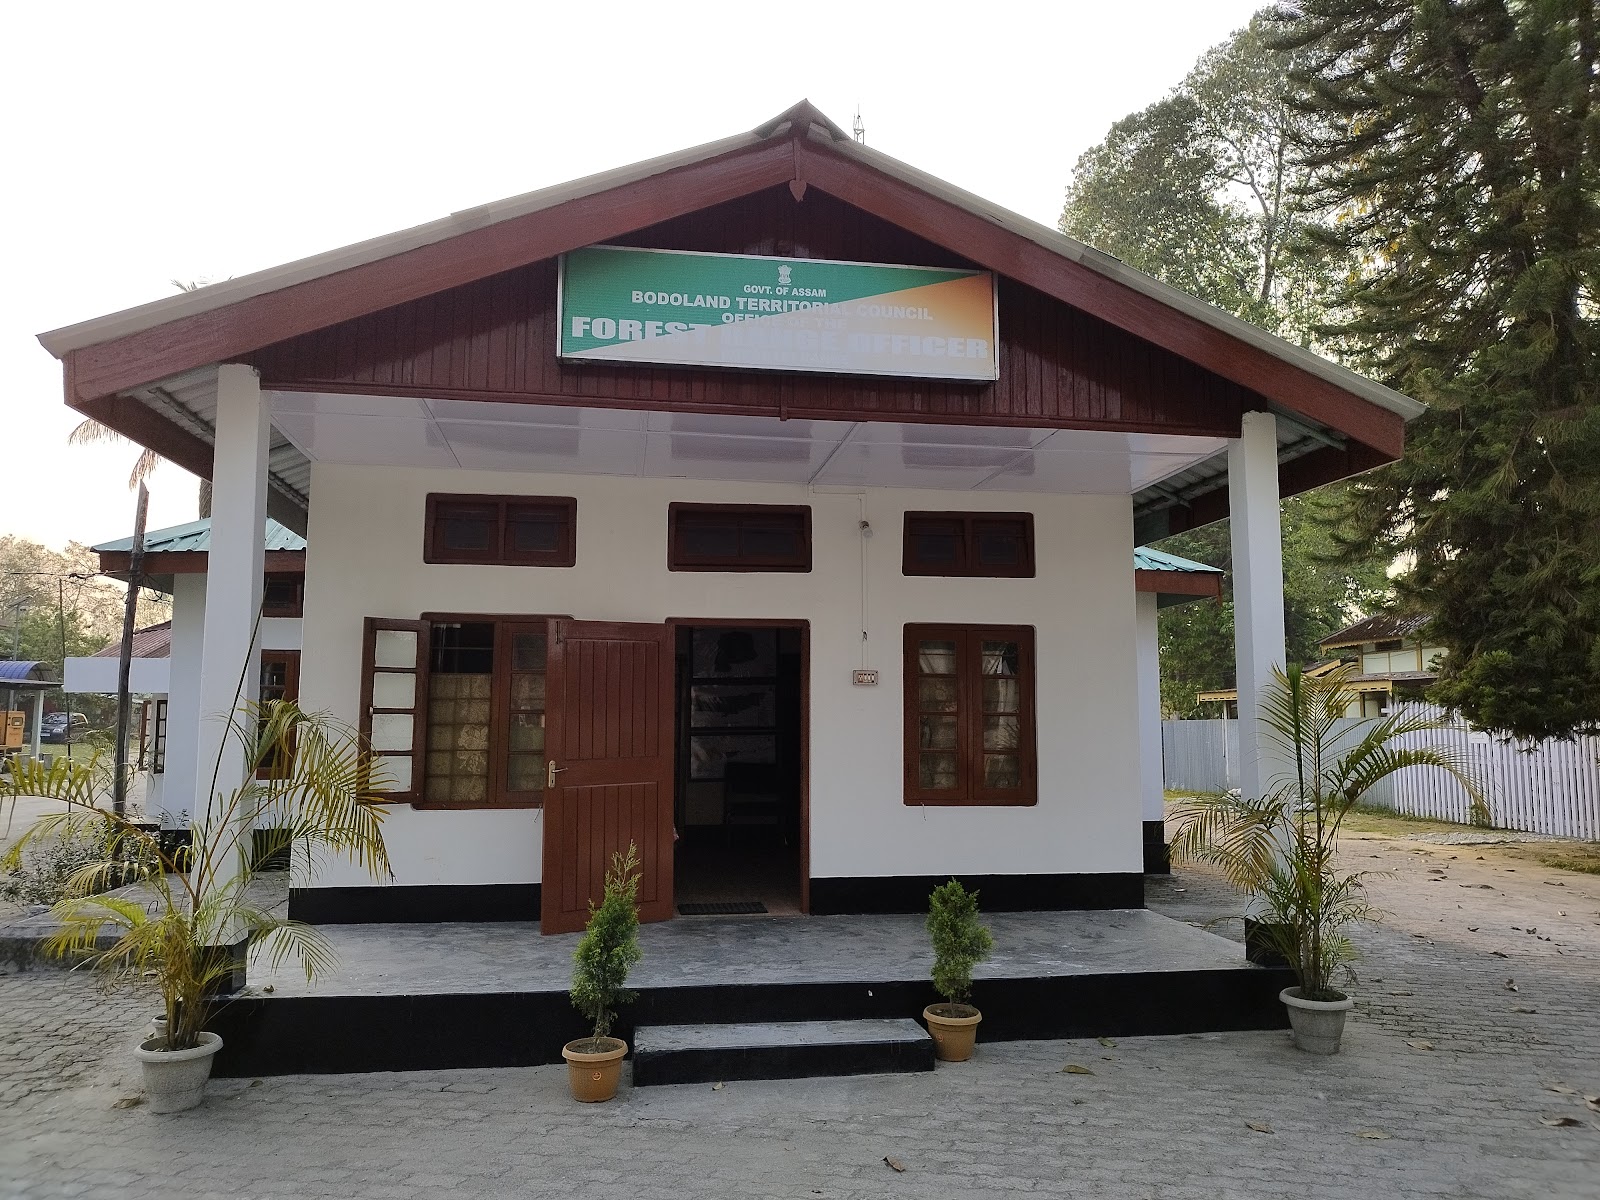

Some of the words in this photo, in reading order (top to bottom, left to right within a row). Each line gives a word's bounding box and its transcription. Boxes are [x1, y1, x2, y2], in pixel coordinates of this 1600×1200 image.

[743, 284, 773, 295] GOVT.
[775, 286, 789, 296] OF
[791, 287, 827, 298] ASSAM
[631, 290, 731, 309] BODOLAND
[735, 297, 849, 316] TERRITORIAL
[856, 304, 934, 321] COUNCIL
